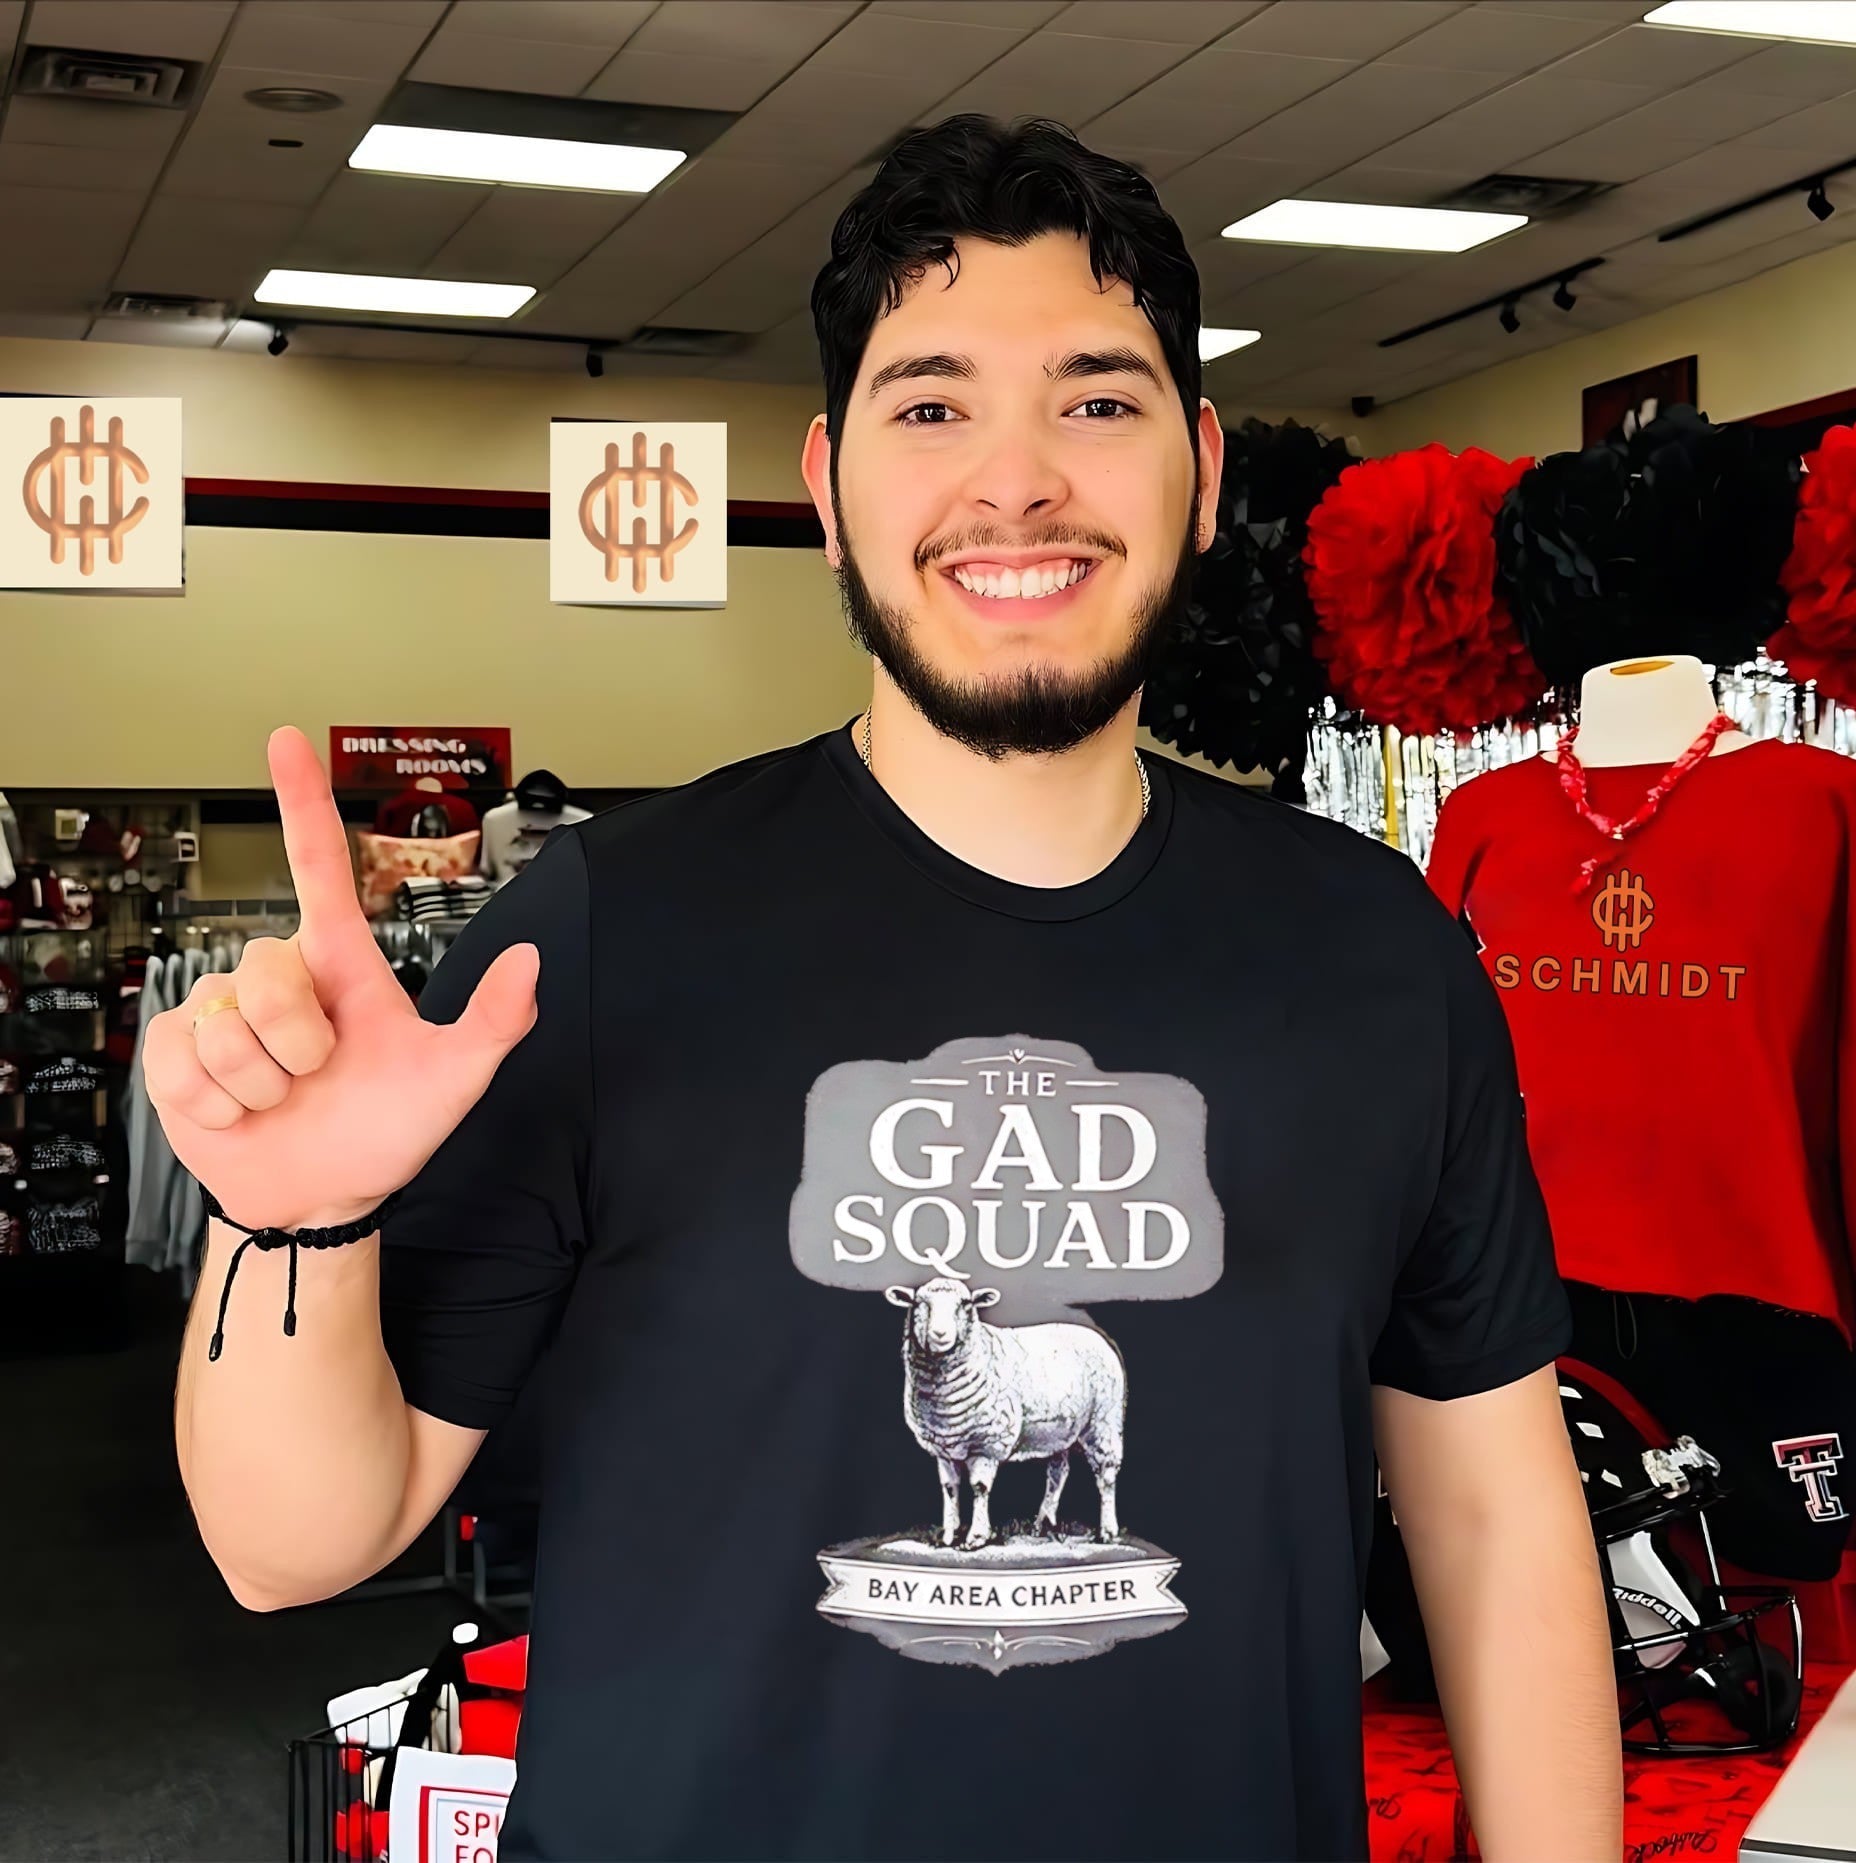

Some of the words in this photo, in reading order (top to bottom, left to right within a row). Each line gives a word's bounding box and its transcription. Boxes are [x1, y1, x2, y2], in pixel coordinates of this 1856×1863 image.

[342, 737, 467, 754] DRESSING
[396, 758, 487, 775] ROOMS
[1494, 953, 1746, 1000] SCHMIDT
[978, 1070, 1057, 1097] THE
[868, 1098, 1158, 1192] GAD
[832, 1194, 1191, 1280] SQUAD
[867, 1578, 920, 1602] BAY
[929, 1583, 1002, 1608] AREA
[1011, 1579, 1138, 1608] CHAPTER
